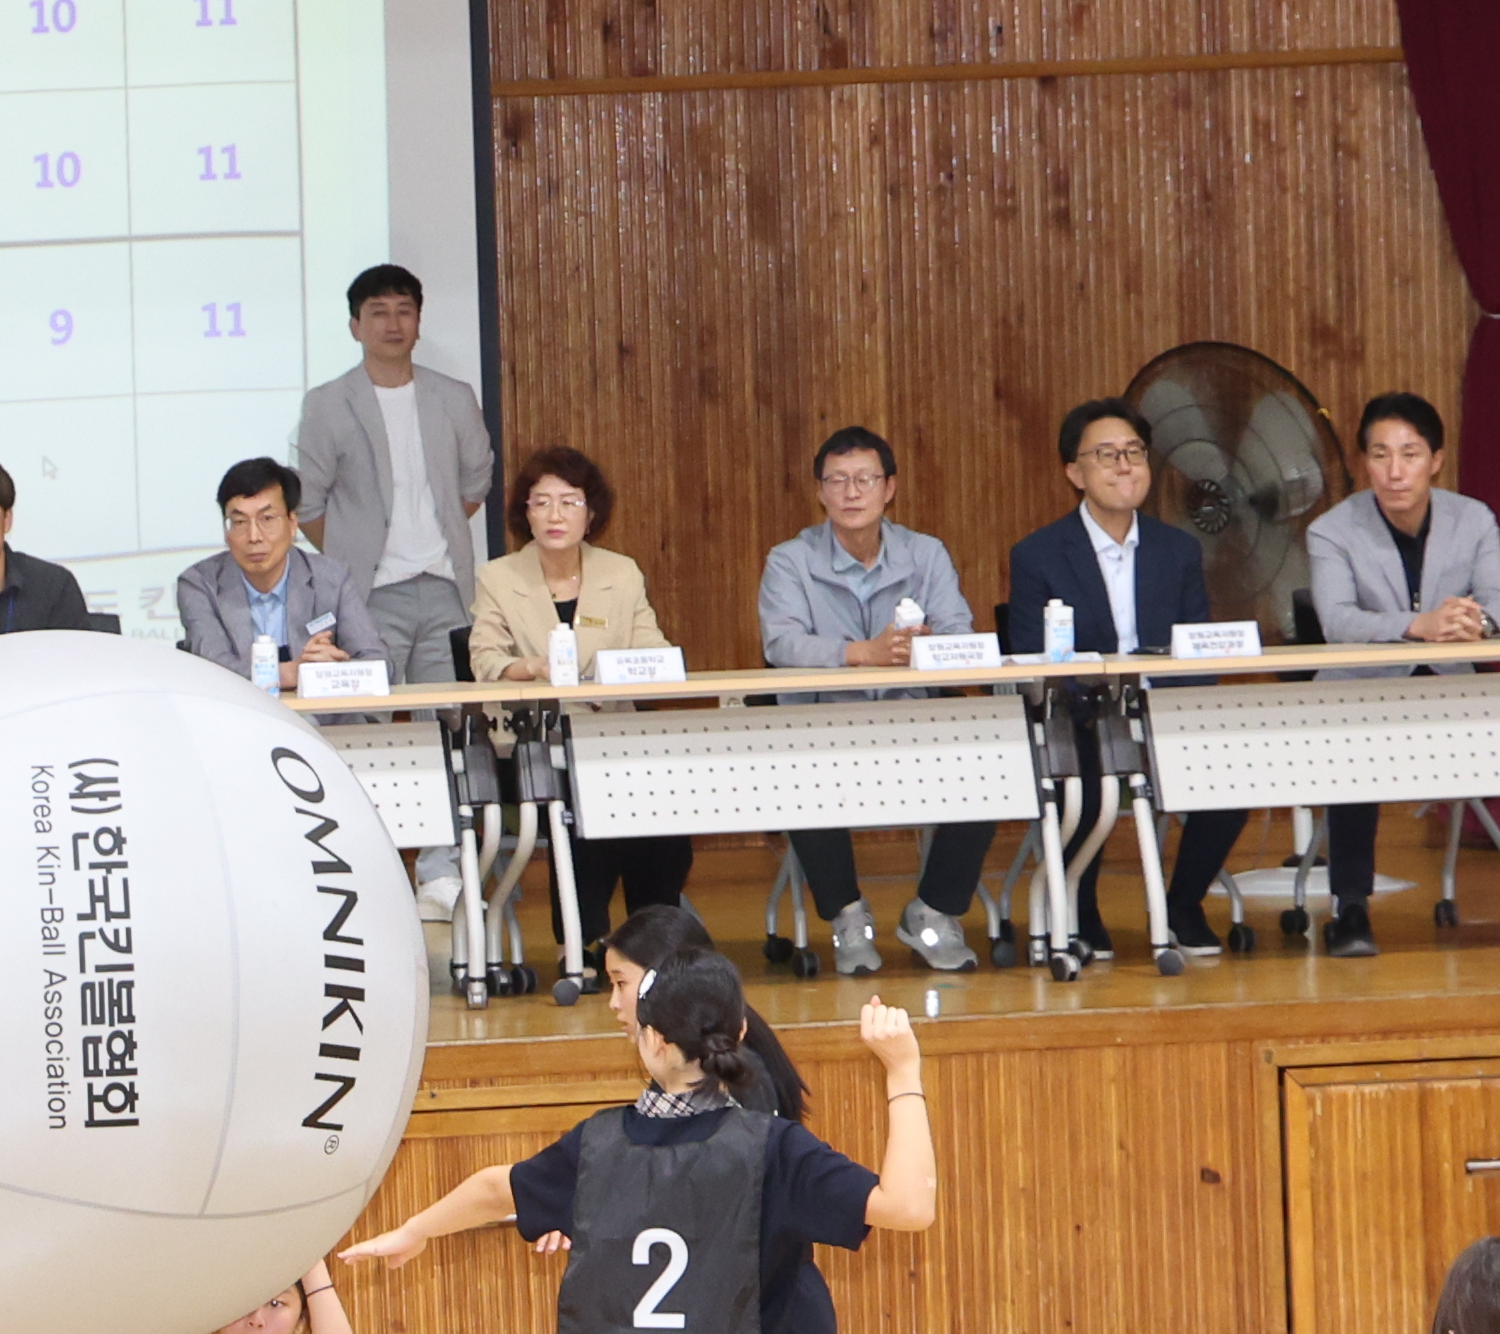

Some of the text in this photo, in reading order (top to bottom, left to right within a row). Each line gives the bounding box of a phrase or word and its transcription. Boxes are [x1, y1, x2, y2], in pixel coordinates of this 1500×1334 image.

[34, 152, 82, 188] 10
[198, 144, 242, 180] 11
[50, 309, 74, 346] 9
[202, 302, 246, 337] 11
[31, 765, 69, 1129] Korea Kin-Ball Association
[631, 1228, 688, 1328] 2
